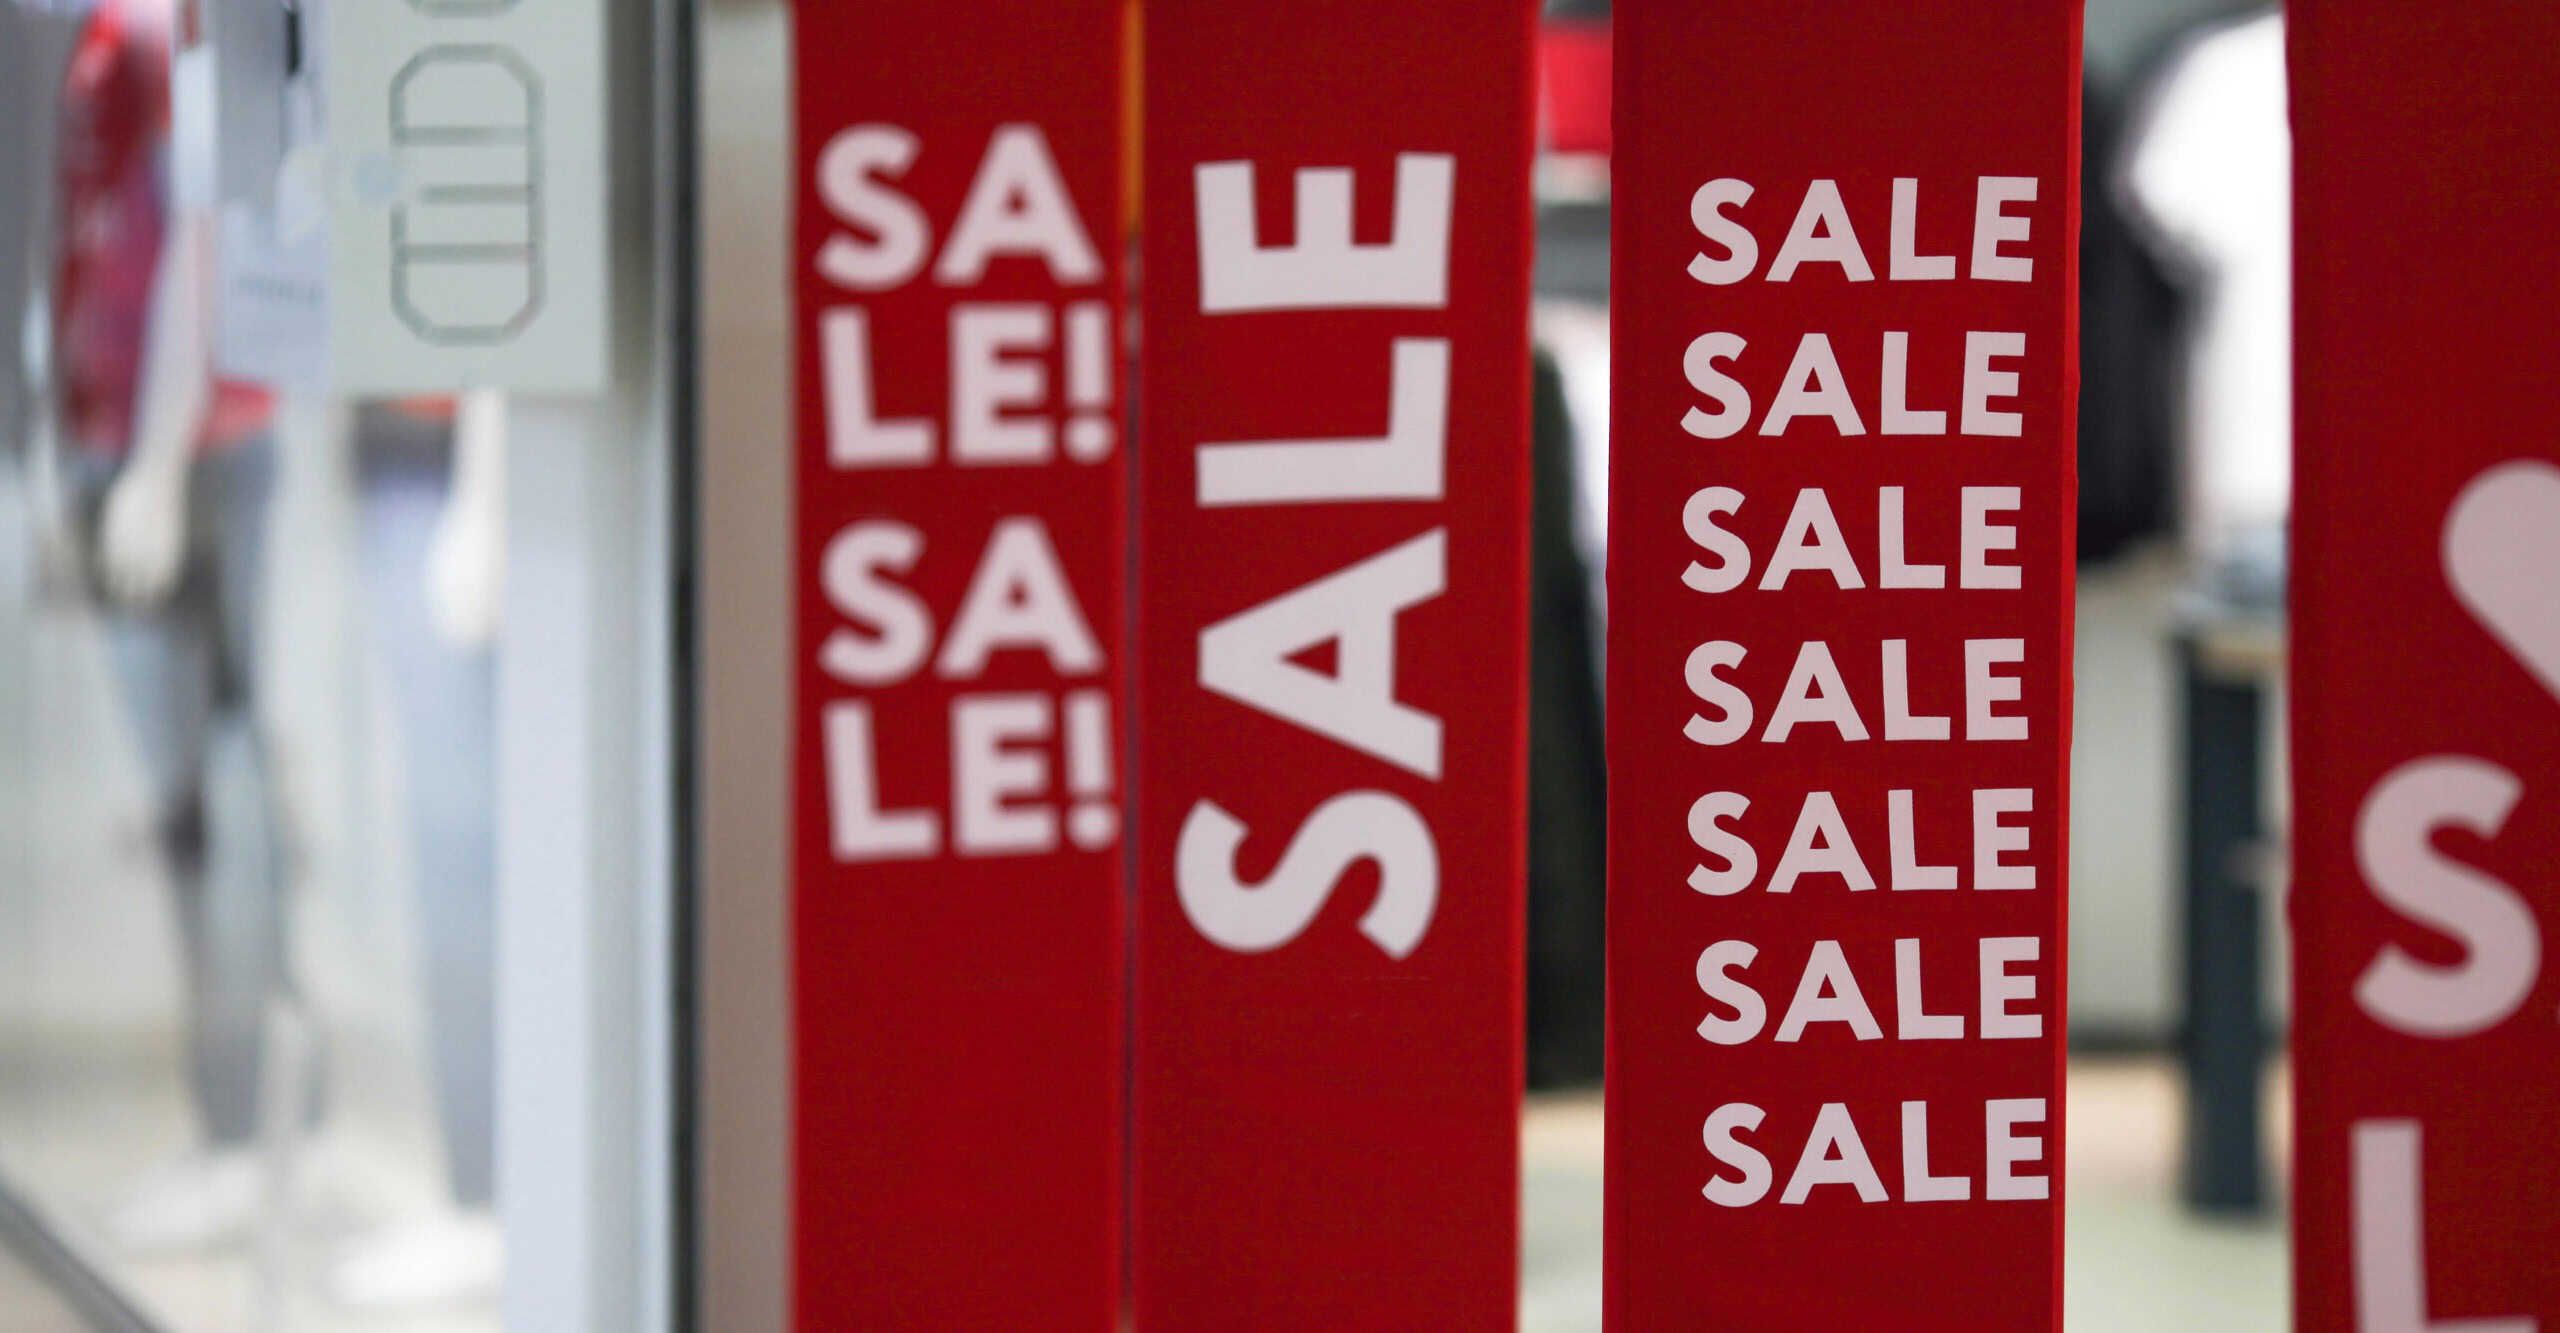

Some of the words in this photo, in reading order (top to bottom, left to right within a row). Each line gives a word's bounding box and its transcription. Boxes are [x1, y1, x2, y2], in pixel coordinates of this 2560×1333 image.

[816, 124, 1102, 290] SA
[1687, 175, 2039, 285] SALE
[819, 304, 1116, 469] LE!
[1680, 331, 2027, 439] SALE
[1178, 153, 1454, 958] SALE
[1681, 486, 2024, 594] SALE
[820, 518, 1104, 684] SA
[1682, 638, 2030, 745] SALE
[823, 690, 1119, 860] LE!
[1687, 788, 2037, 896] SALE
[2354, 754, 2560, 1037] S
[1696, 936, 2044, 1045] SALE
[1702, 1098, 2049, 1208] SALE
